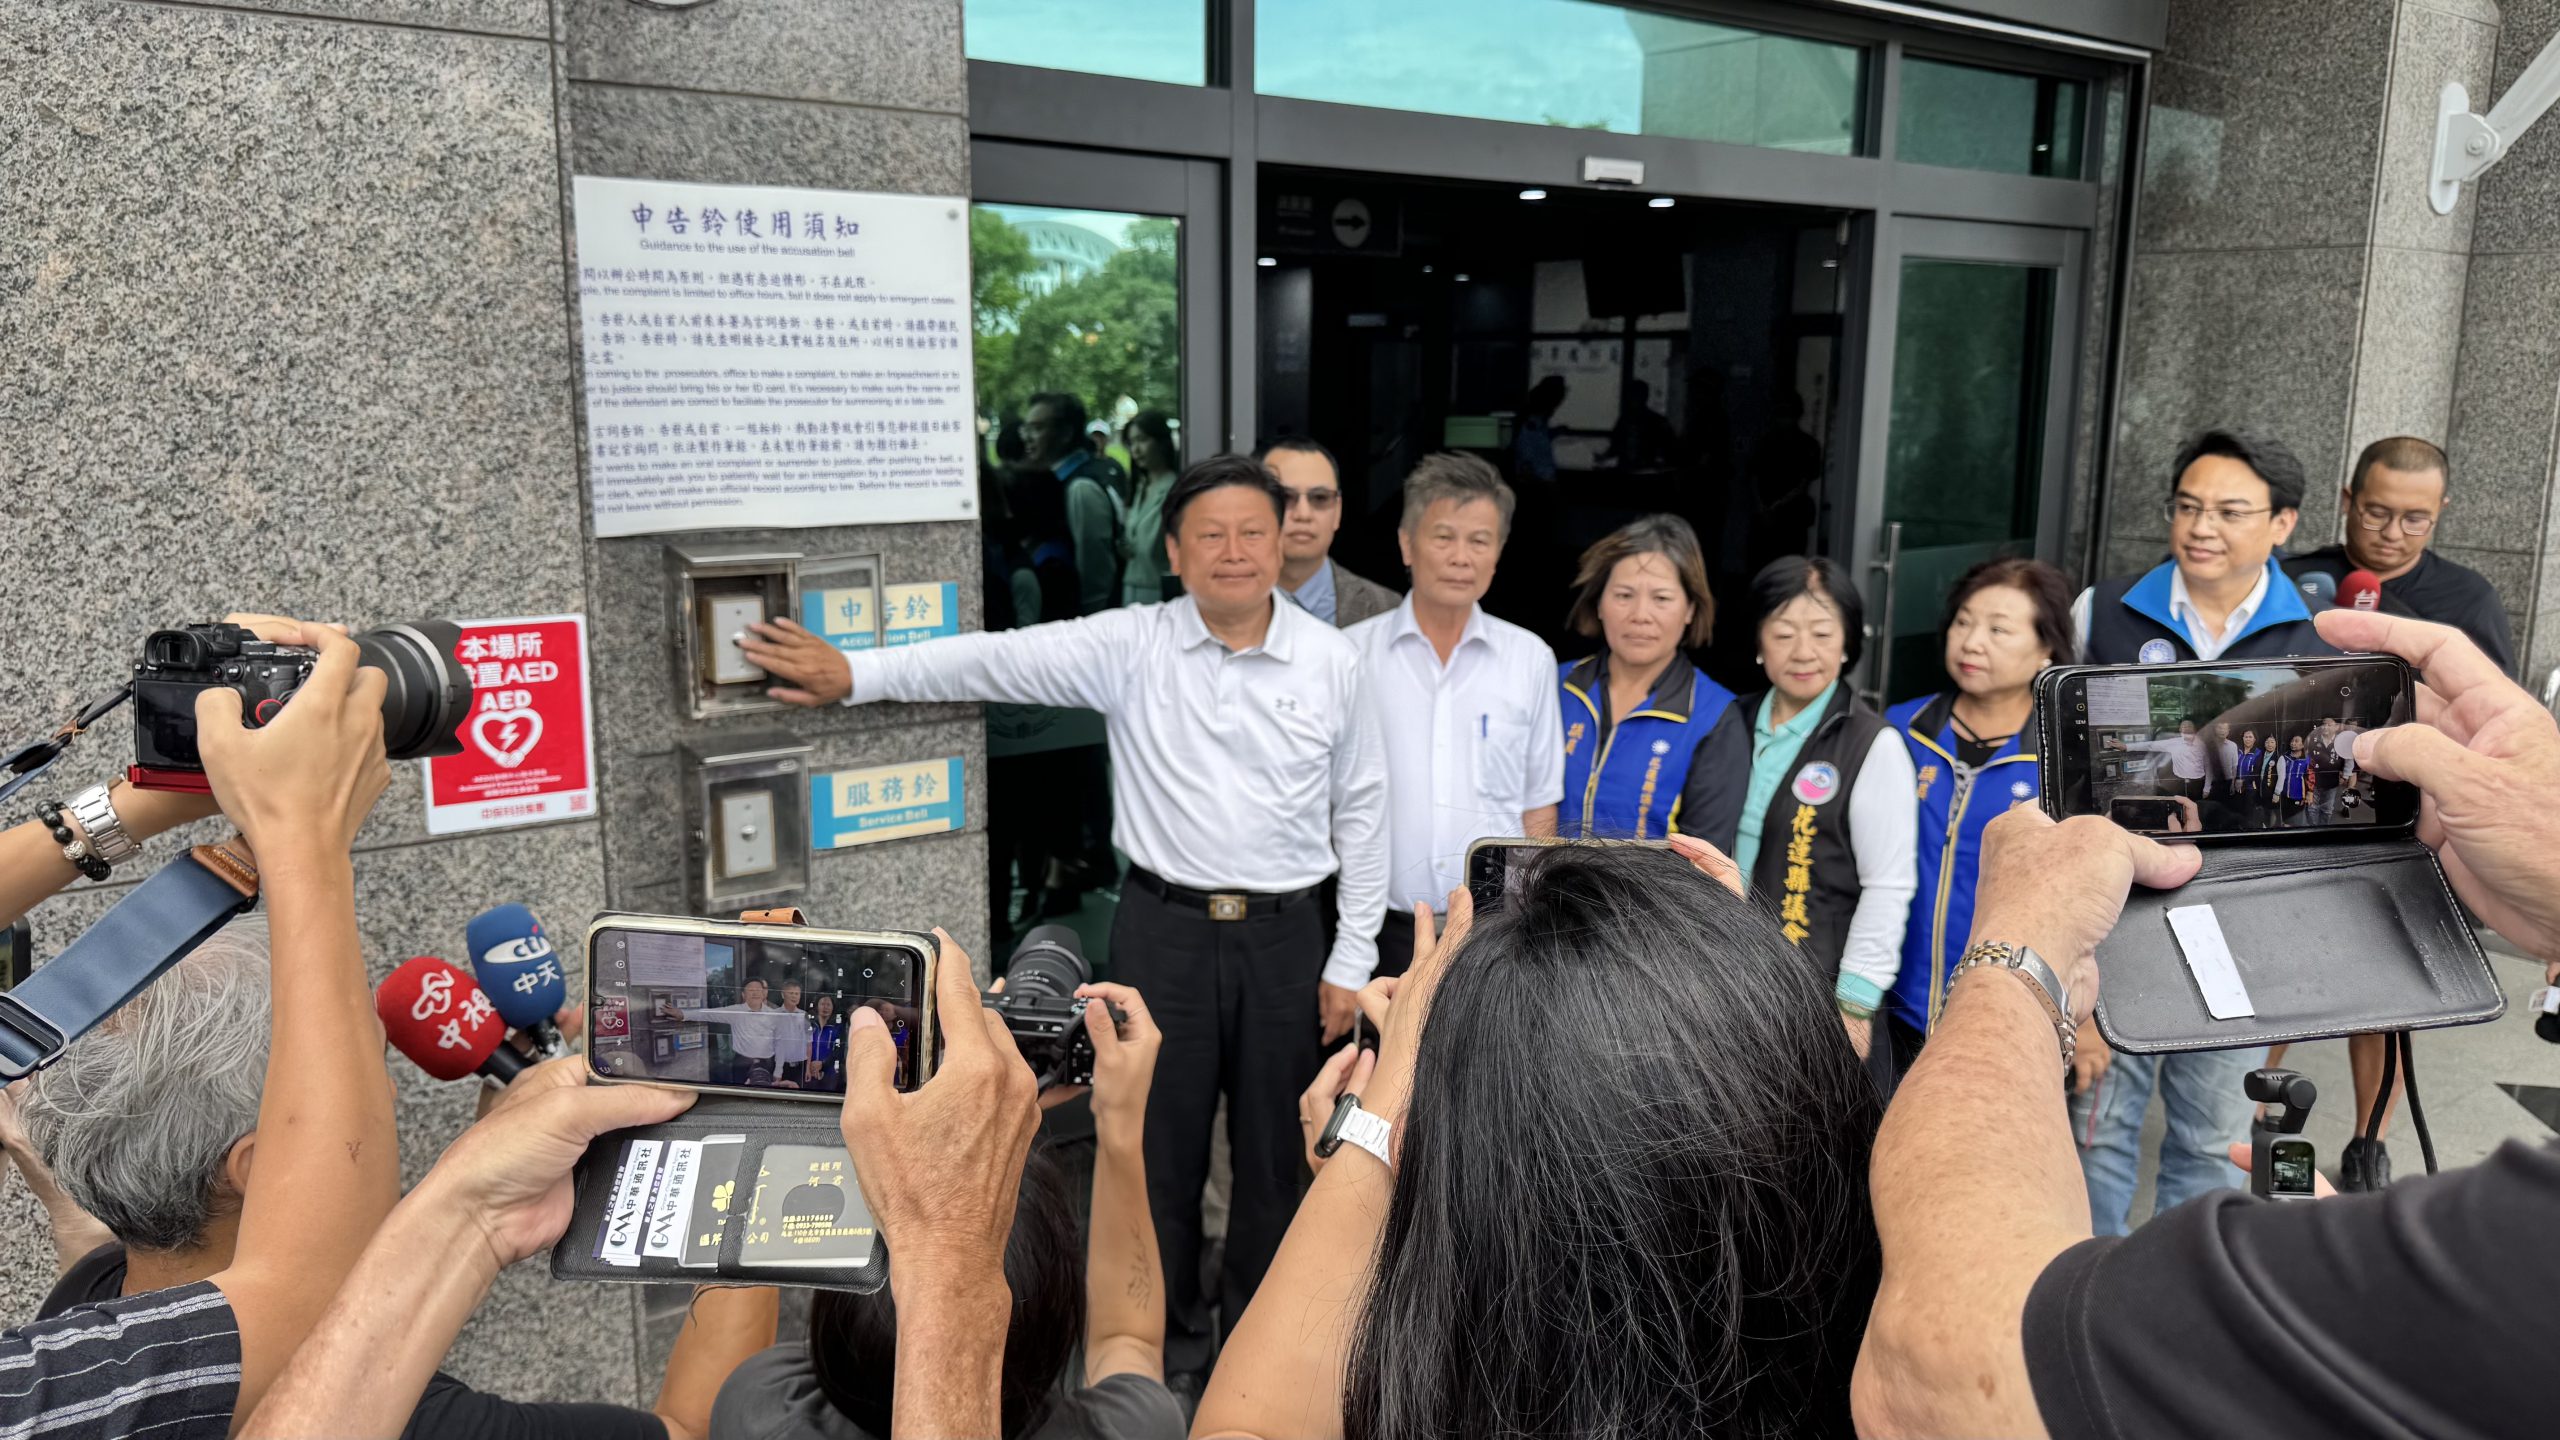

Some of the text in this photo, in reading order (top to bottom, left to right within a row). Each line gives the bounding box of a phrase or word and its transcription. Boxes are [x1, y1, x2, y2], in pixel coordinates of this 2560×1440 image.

[631, 202, 861, 241] 申告鈴使用須知
[638, 239, 692, 252] Guidance
[693, 242, 705, 253] to
[707, 242, 723, 253] the
[726, 244, 746, 254] use
[748, 243, 760, 254] of
[759, 243, 778, 254] the
[836, 247, 855, 258] bell
[603, 285, 620, 296] the
[621, 286, 670, 297] complaint
[671, 287, 681, 298] is
[682, 288, 715, 298] limited
[716, 288, 726, 299] to
[728, 288, 754, 299] office
[632, 369, 643, 378] to
[644, 368, 660, 378] the
[749, 369, 760, 379] to
[611, 384, 643, 394] justice
[644, 384, 677, 393] should
[679, 383, 704, 393] bring
[752, 381, 763, 393] ID
[461, 632, 543, 662] 本場所
[841, 630, 931, 647] Accuion Bell
[480, 689, 532, 711] AED
[847, 772, 938, 807] 服務鈴
[859, 808, 929, 828] Service Bell
[513, 960, 561, 995] 中天
[437, 987, 497, 1051] 中視
[626, 1147, 653, 1211] 中華通訊社
[666, 1147, 692, 1212] 中華通訊社
